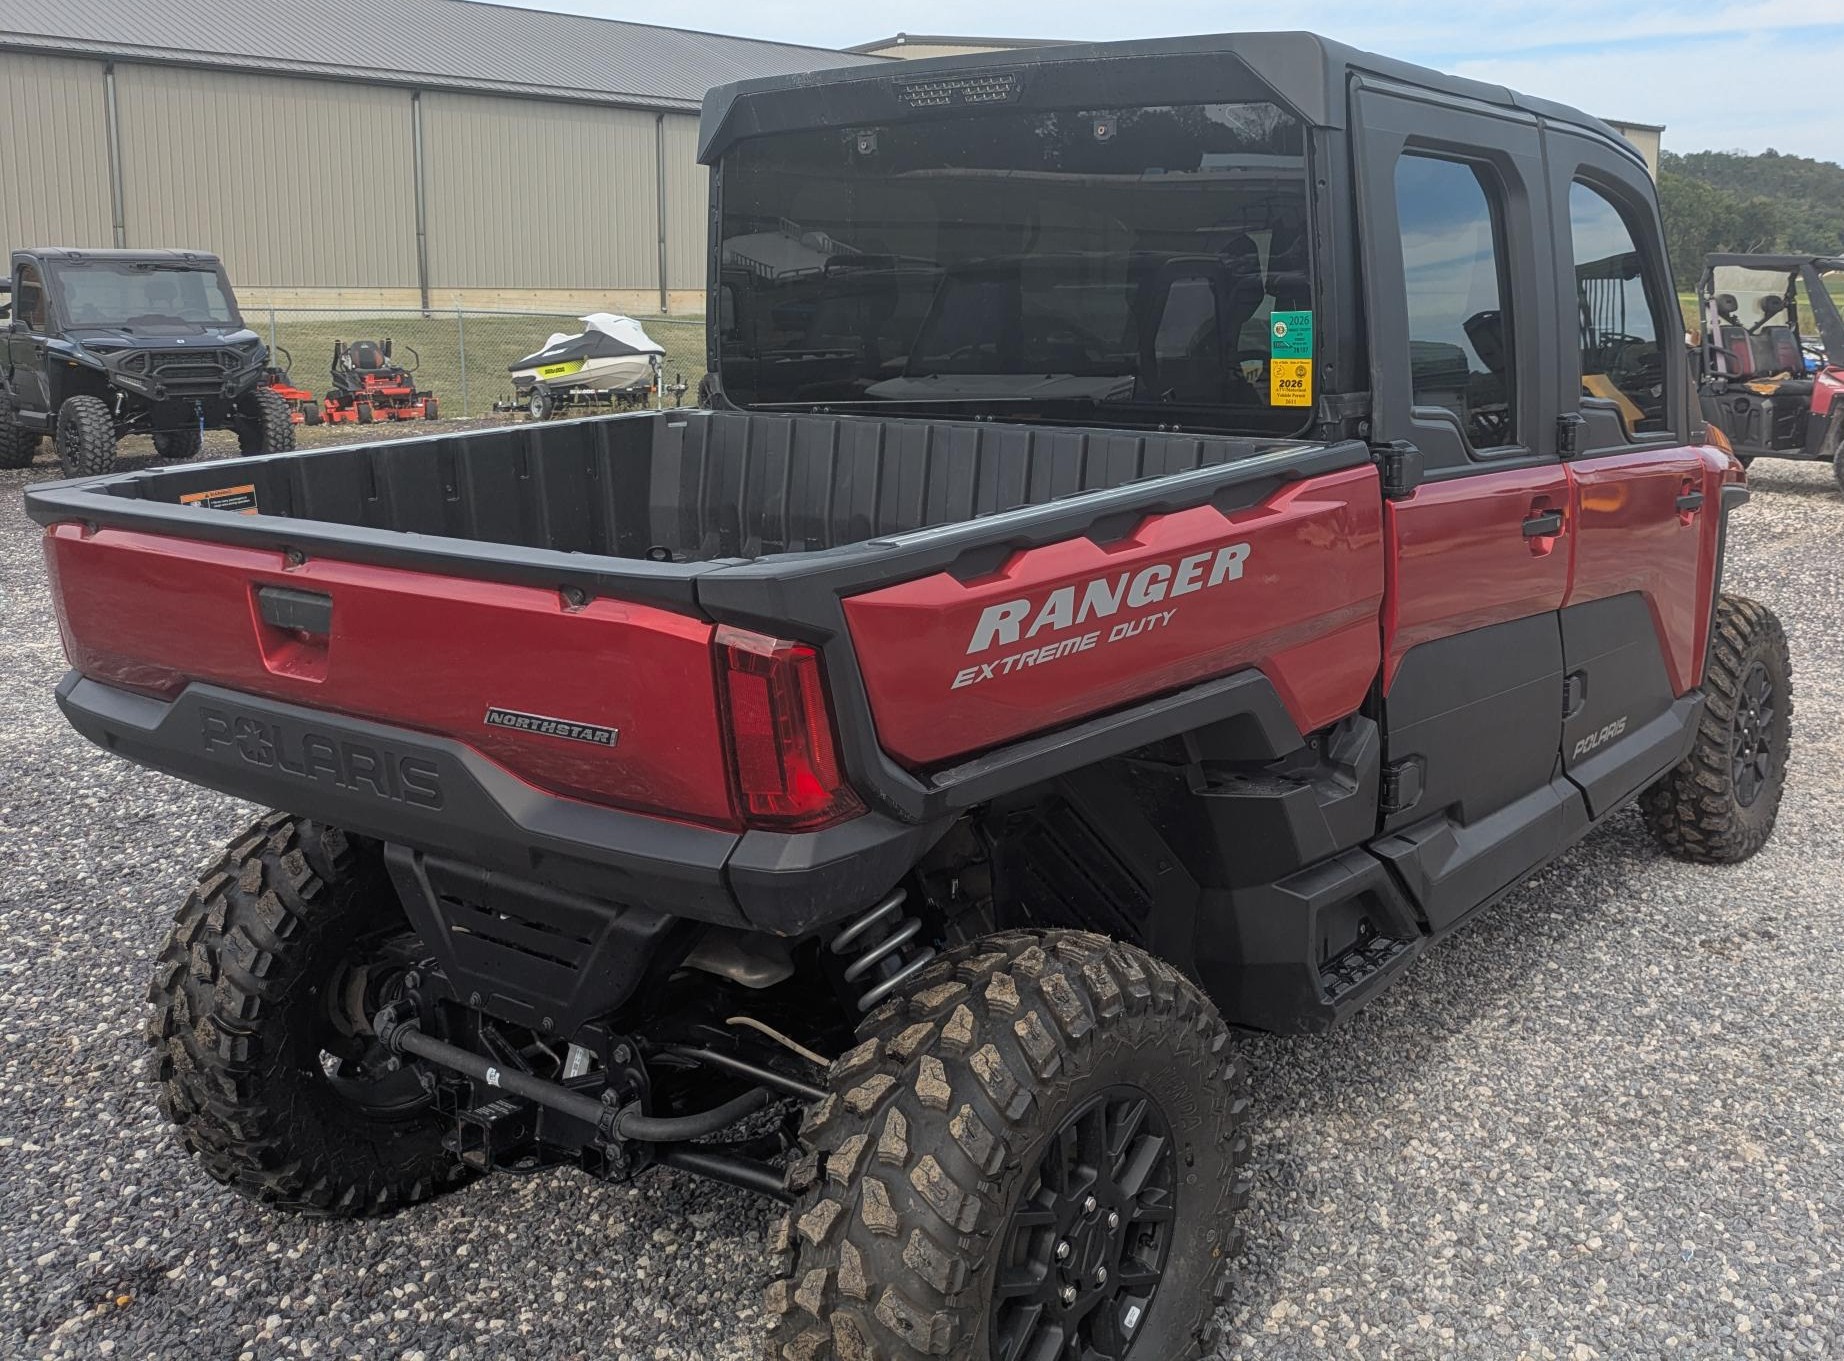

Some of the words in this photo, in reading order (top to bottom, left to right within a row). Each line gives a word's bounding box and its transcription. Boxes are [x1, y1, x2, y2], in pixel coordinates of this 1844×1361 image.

[1289, 316, 1310, 326] 2026
[1279, 379, 1303, 388] 2026
[966, 543, 1251, 655] RANGER
[950, 631, 1101, 690] EXTREME
[1107, 608, 1178, 643] DUTY
[489, 711, 610, 743] NORTHSTAR
[1572, 716, 1628, 760] POLARIS
[203, 714, 443, 812] POLARIS
